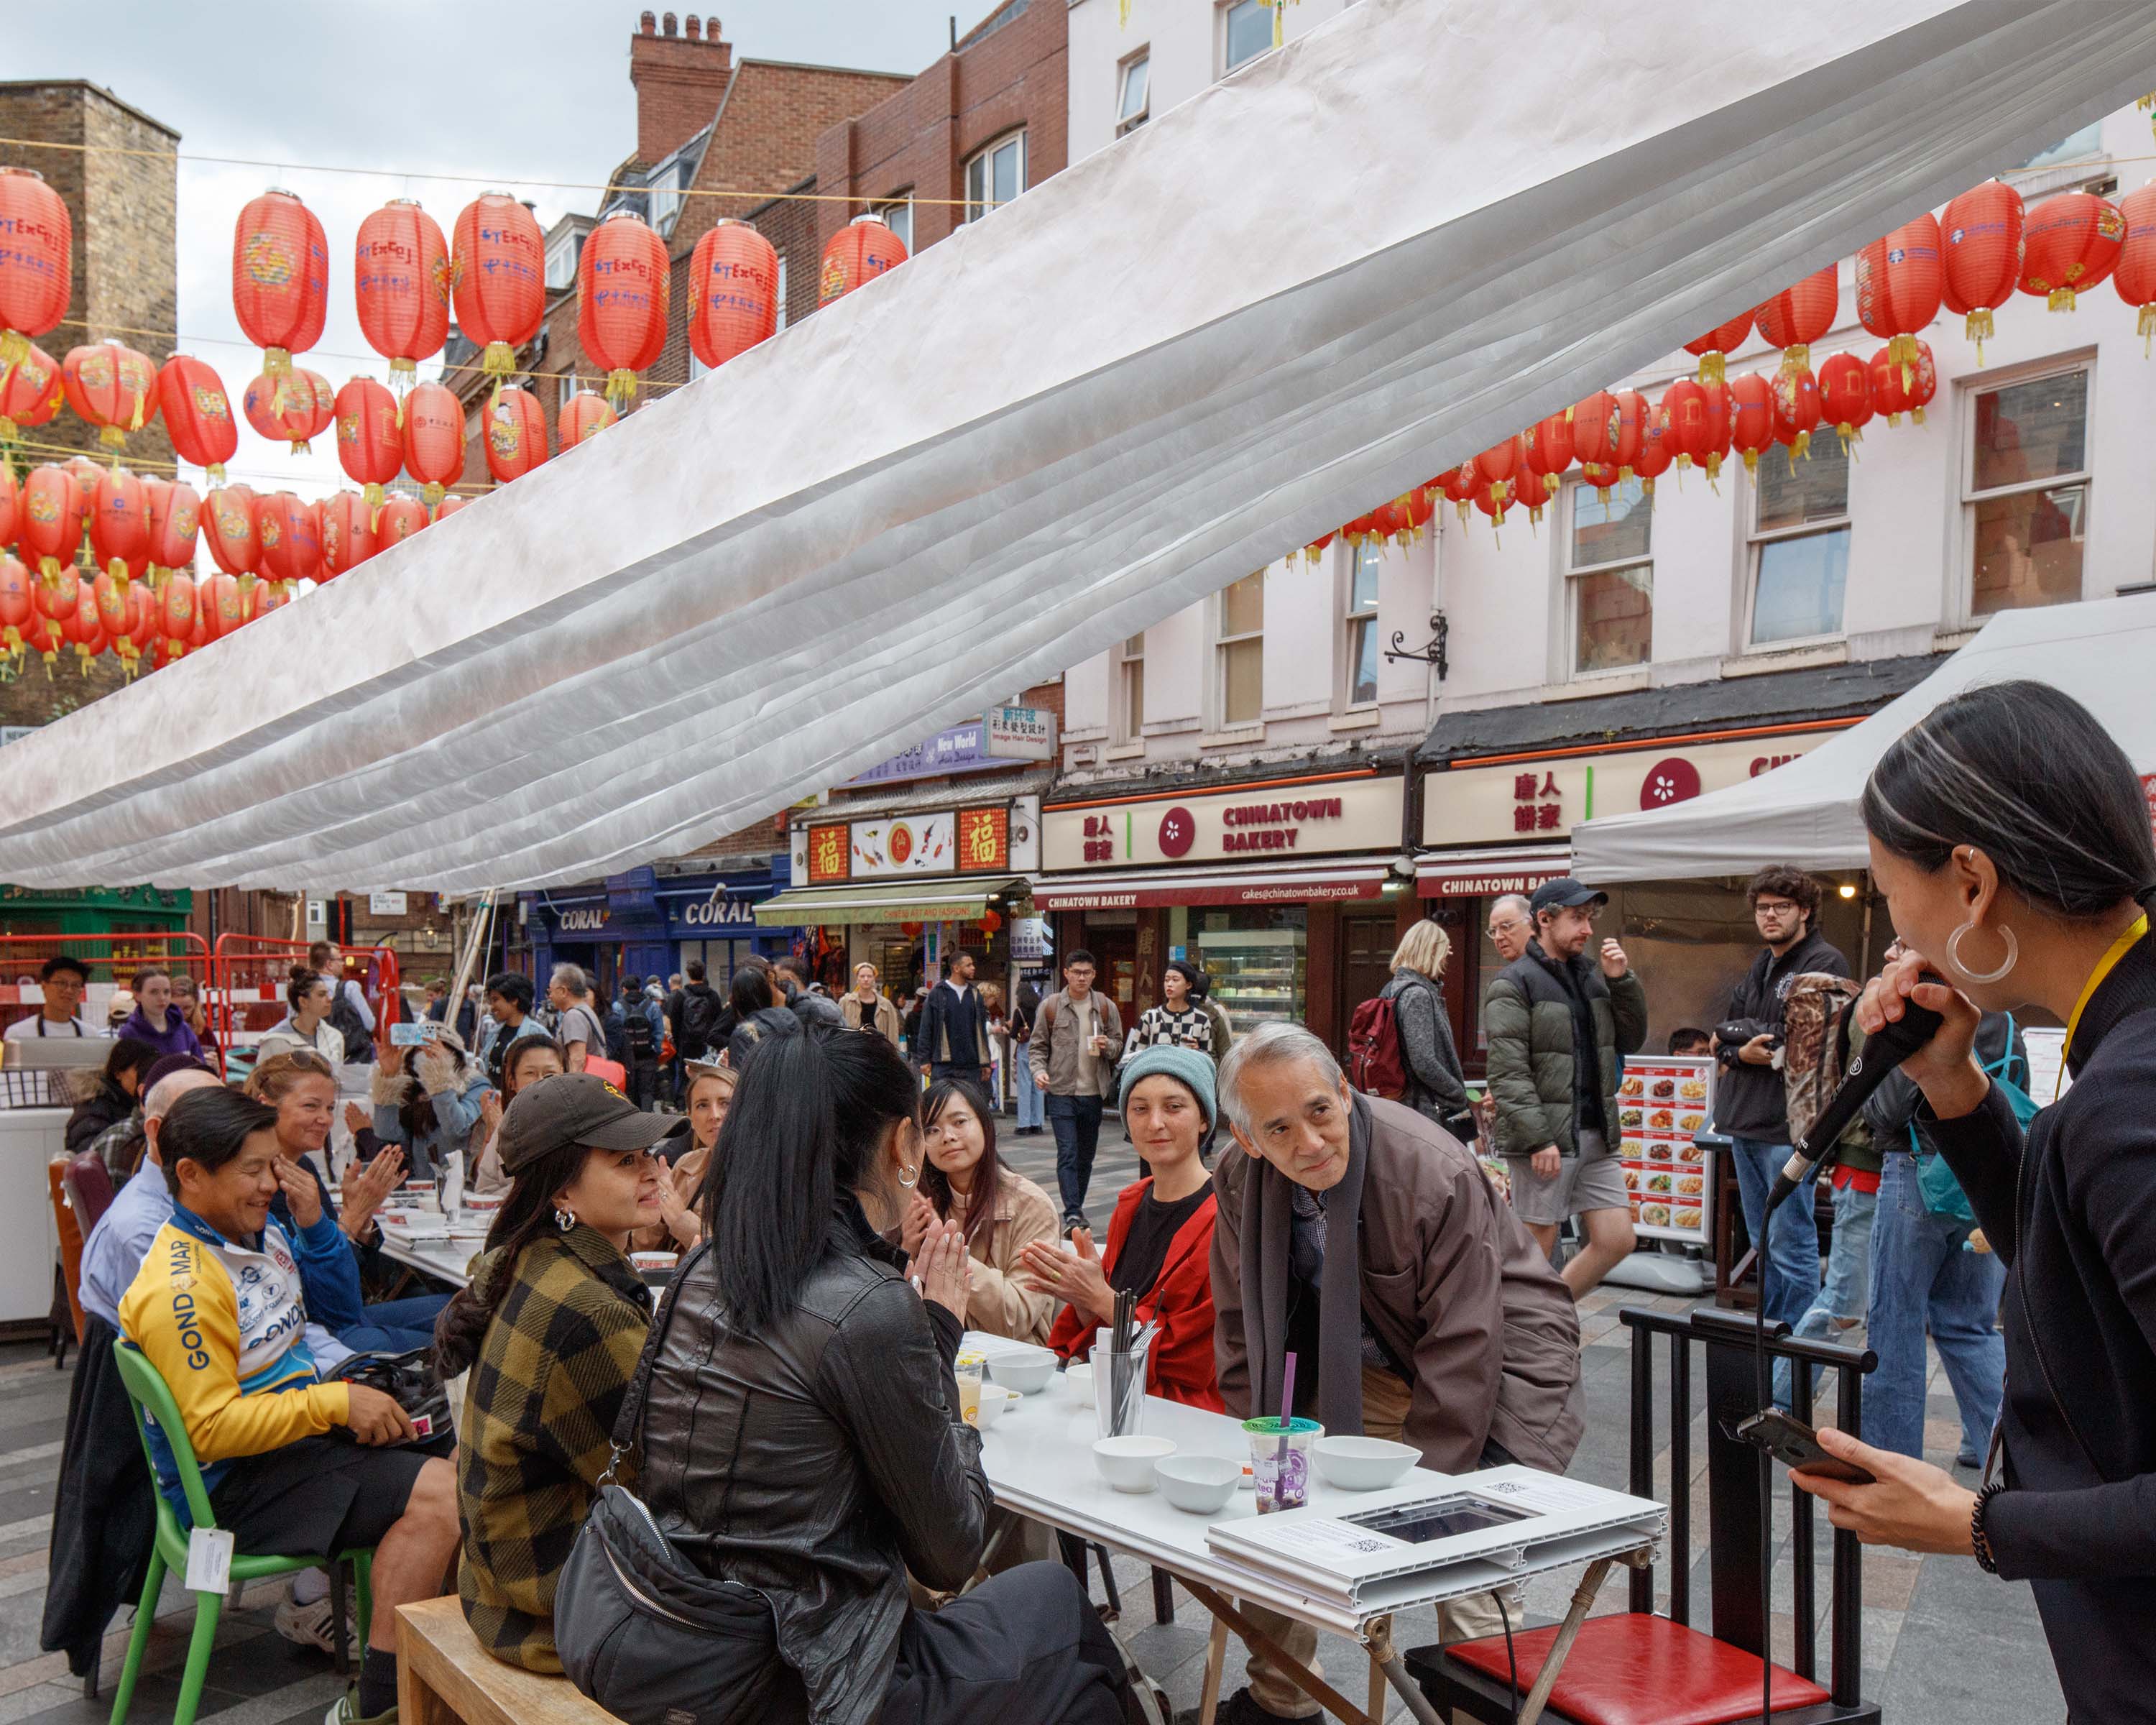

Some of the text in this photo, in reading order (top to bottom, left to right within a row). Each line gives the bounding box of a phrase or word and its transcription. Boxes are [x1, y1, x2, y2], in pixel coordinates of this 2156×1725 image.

[937, 737, 954, 753] New
[954, 730, 976, 750] World
[992, 732, 1010, 742] Image
[1026, 735, 1047, 745] Design
[1514, 770, 1562, 800] 唐人
[1222, 797, 1342, 827] CHINATOWN
[969, 814, 997, 863] 福
[1222, 828, 1299, 852] BAKERY
[818, 831, 840, 875] 福
[1241, 885, 1359, 900] cakes@chinatownbakery.co.uk
[1442, 877, 1524, 894] CHINATOWN
[923, 908, 938, 916] AND
[1048, 895, 1137, 908] CHINATOWN BAKERY
[560, 909, 604, 930] CORAL
[685, 902, 753, 925] CORAL
[170, 1240, 211, 1371] GOND MAR
[1258, 1483, 1273, 1494] tea
